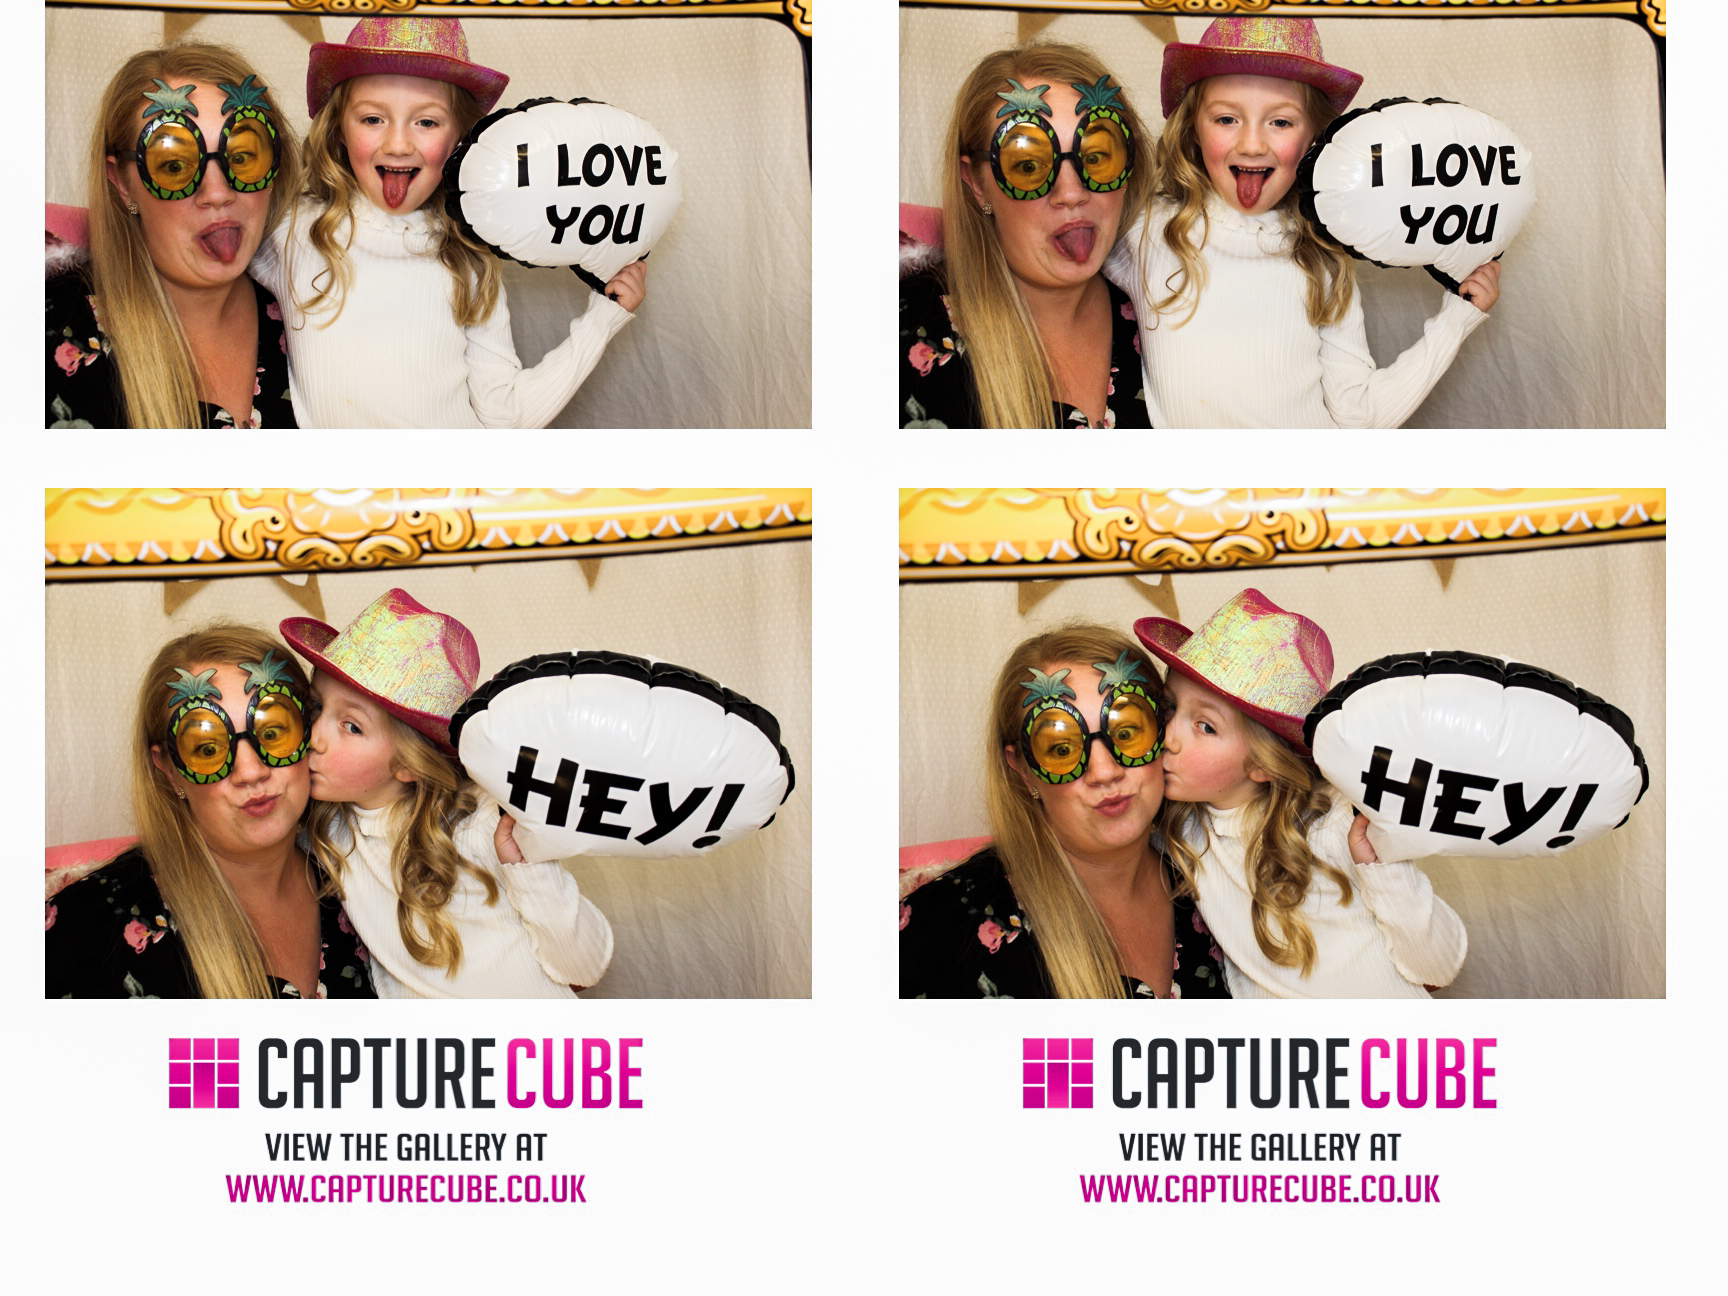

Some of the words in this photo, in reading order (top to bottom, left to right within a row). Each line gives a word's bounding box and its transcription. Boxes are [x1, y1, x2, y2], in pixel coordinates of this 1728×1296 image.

[515, 142, 530, 188] I
[556, 142, 668, 188] LOVE
[1369, 142, 1384, 188] I
[1410, 142, 1522, 188] LOVE
[545, 203, 645, 246] YOU
[1399, 203, 1499, 246] YOU
[505, 745, 745, 849] HEY!
[1359, 745, 1599, 849] HEY!
